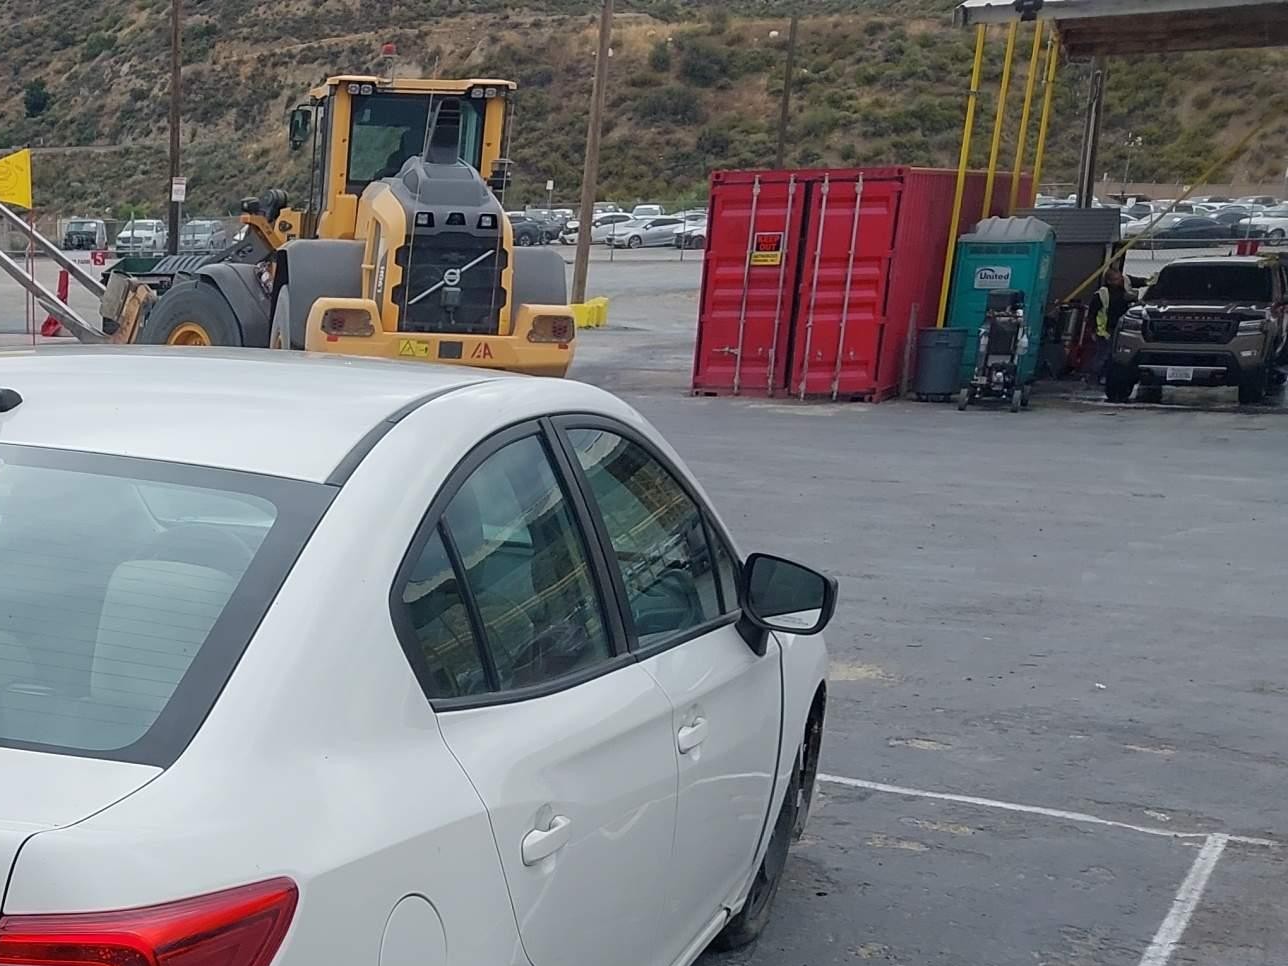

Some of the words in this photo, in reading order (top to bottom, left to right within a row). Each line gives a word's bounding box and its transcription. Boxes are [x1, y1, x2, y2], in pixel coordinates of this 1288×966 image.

[758, 235, 779, 244] KEEP
[95, 252, 103, 265] 5
[978, 271, 1010, 280] United
